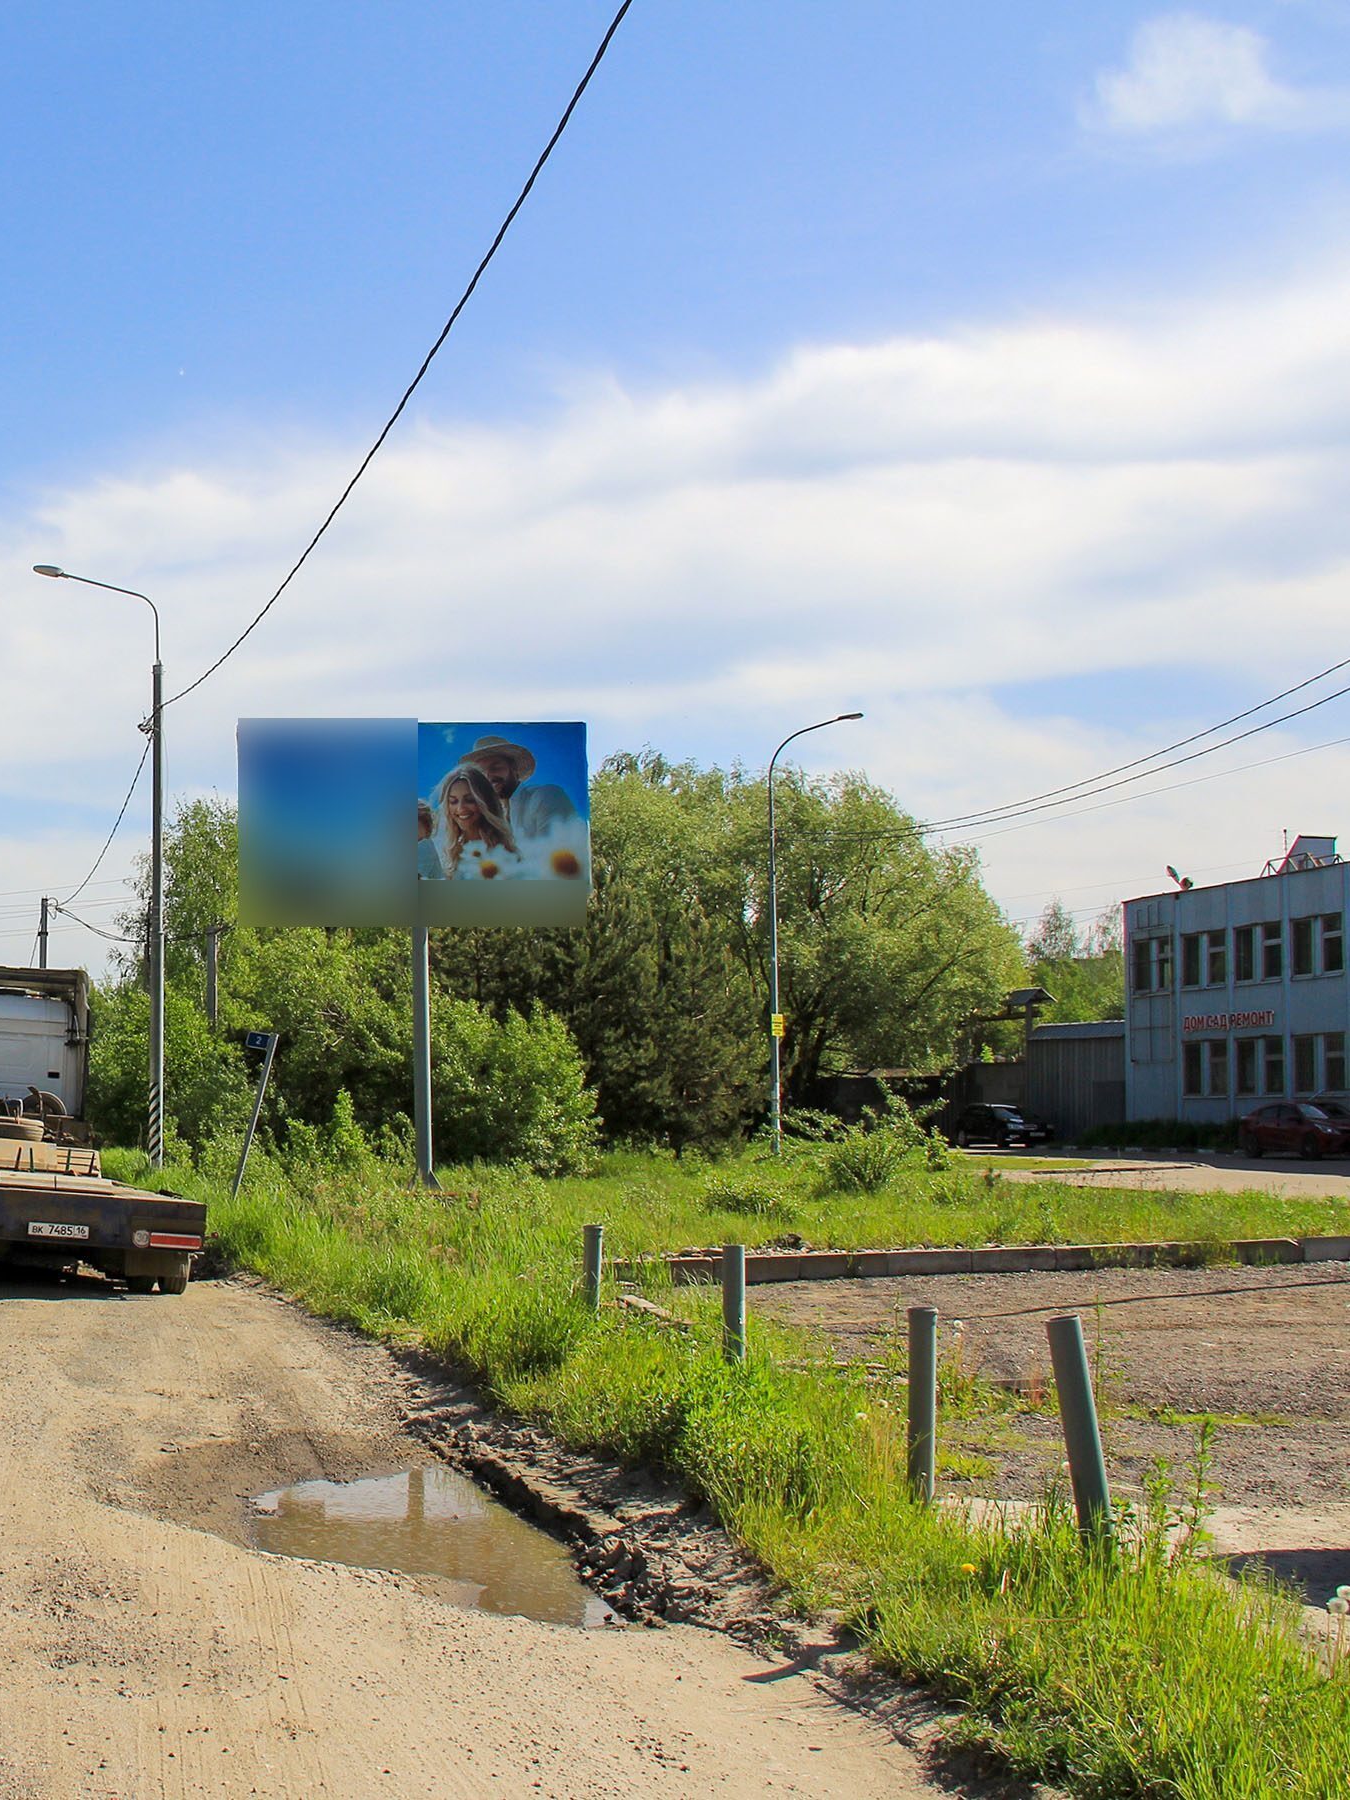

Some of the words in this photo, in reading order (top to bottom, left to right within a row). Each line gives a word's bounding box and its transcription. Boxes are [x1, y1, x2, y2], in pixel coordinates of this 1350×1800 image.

[1184, 1015, 1204, 1032] ДОМ
[1206, 1013, 1229, 1030] САД
[1230, 1010, 1274, 1028] РЕМОНТ
[255, 1036, 262, 1045] 2
[48, 1224, 73, 1236] 7485
[76, 1226, 86, 1235] 16
